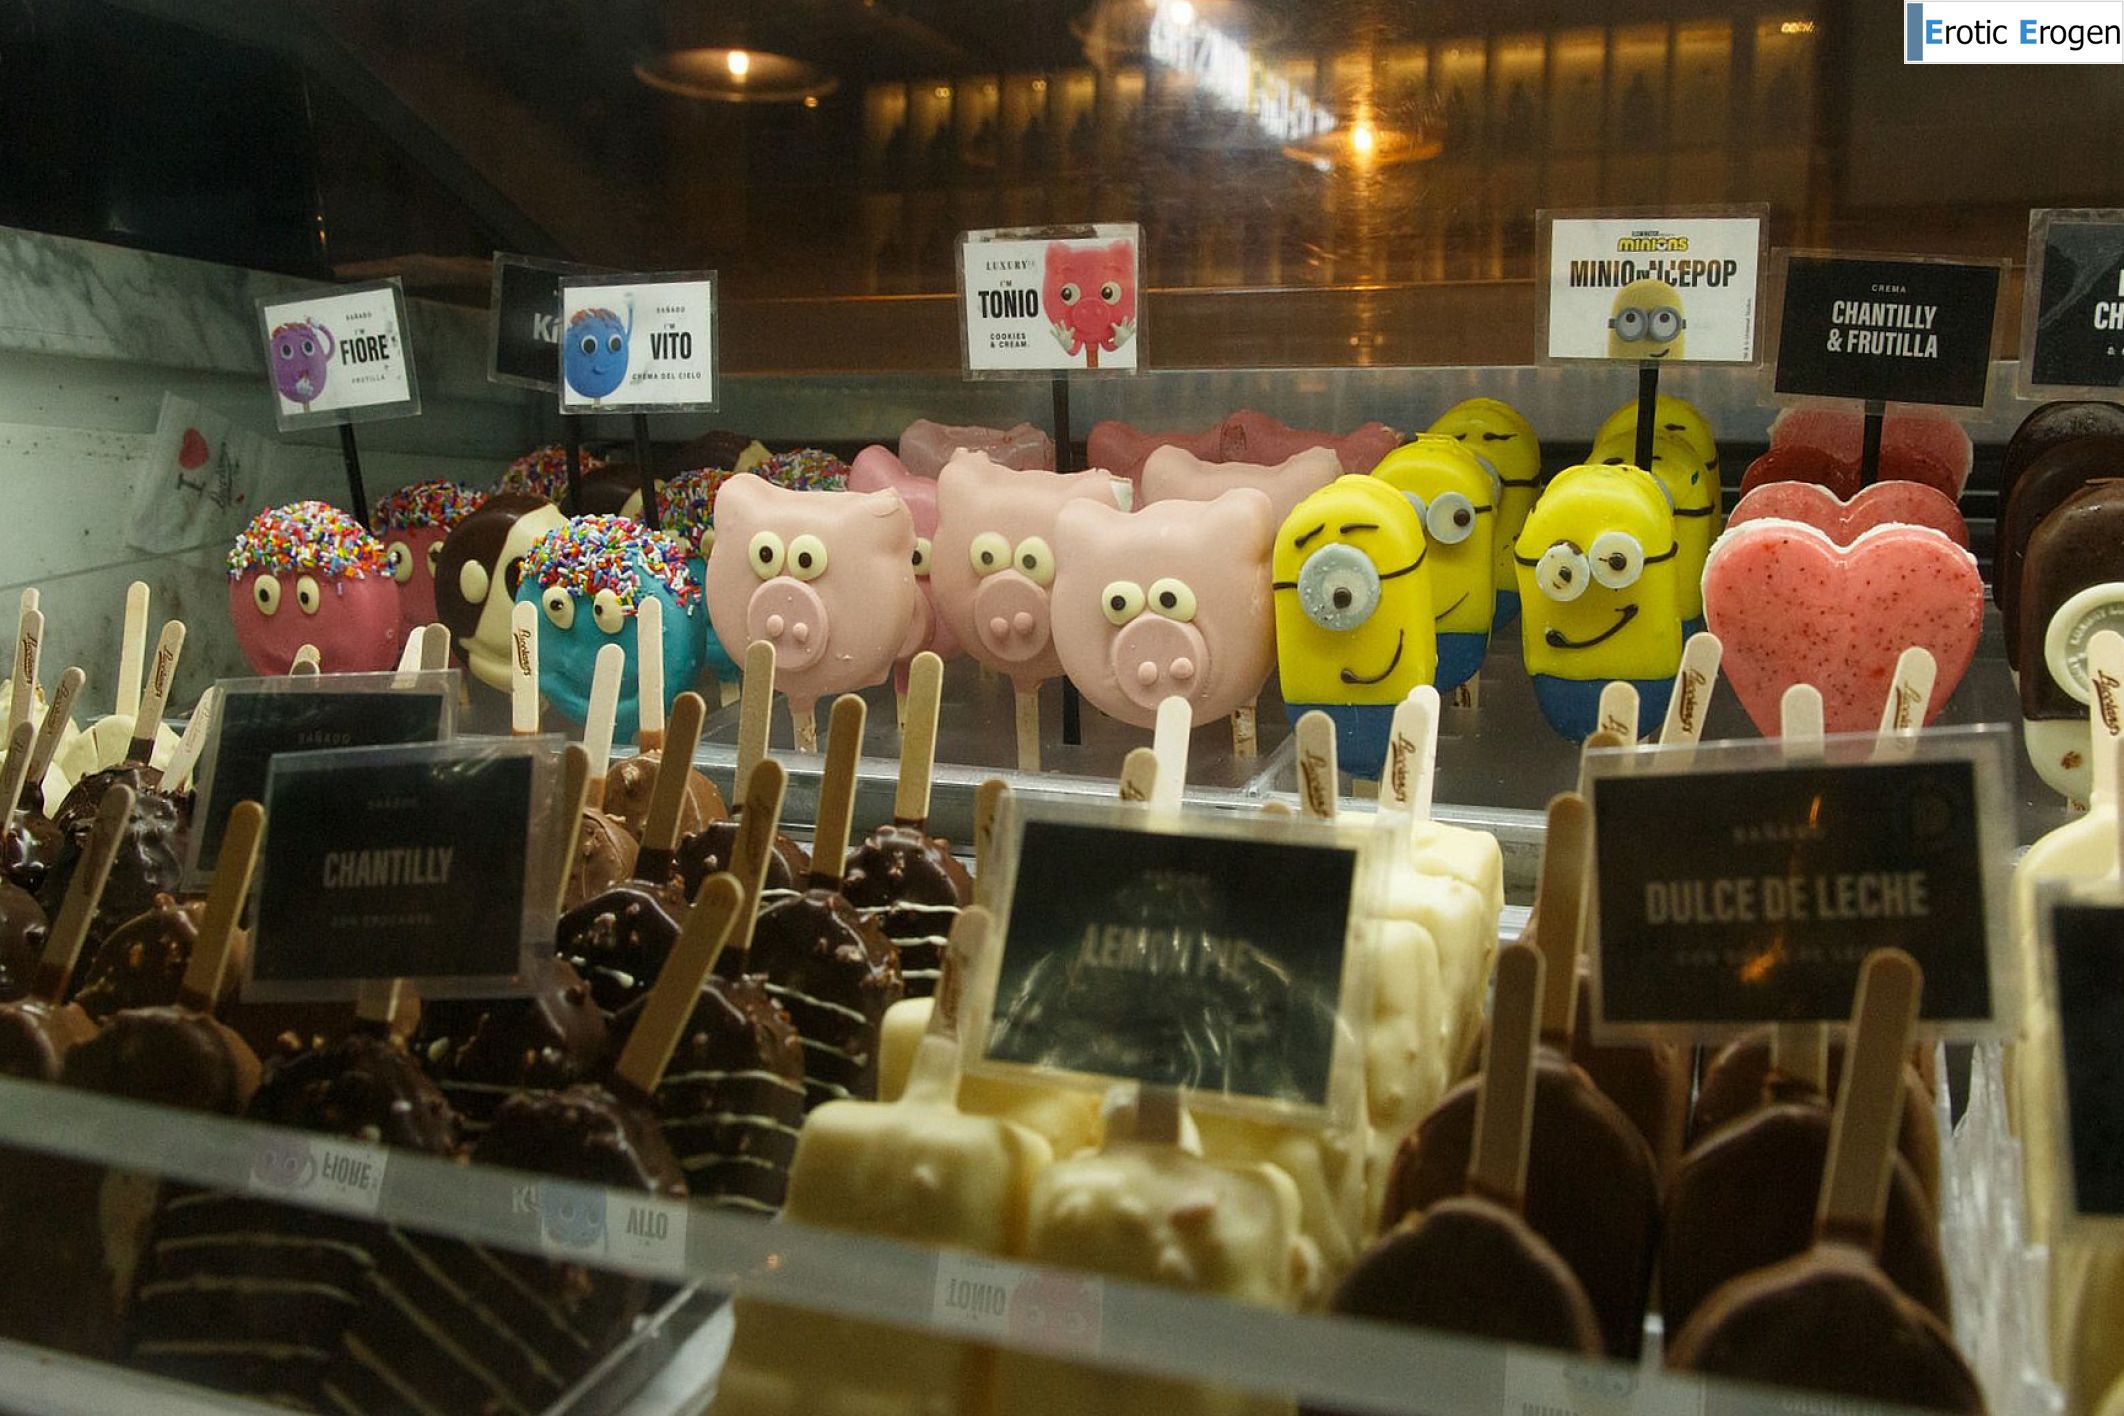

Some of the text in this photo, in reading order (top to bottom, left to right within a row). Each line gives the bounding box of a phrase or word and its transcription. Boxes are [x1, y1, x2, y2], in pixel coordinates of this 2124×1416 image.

[1871, 284, 1906, 293] CREMA
[978, 289, 1038, 318] TONIO
[1832, 300, 1938, 329] CHANTILLY
[340, 334, 389, 365] FIORE
[650, 332, 692, 360] VITO
[990, 333, 1026, 341] COOKIES
[1827, 329, 1938, 358] & FRUTILLA
[322, 845, 455, 889] CHANTILLY
[1644, 869, 1931, 925] DULCE DE LECHE
